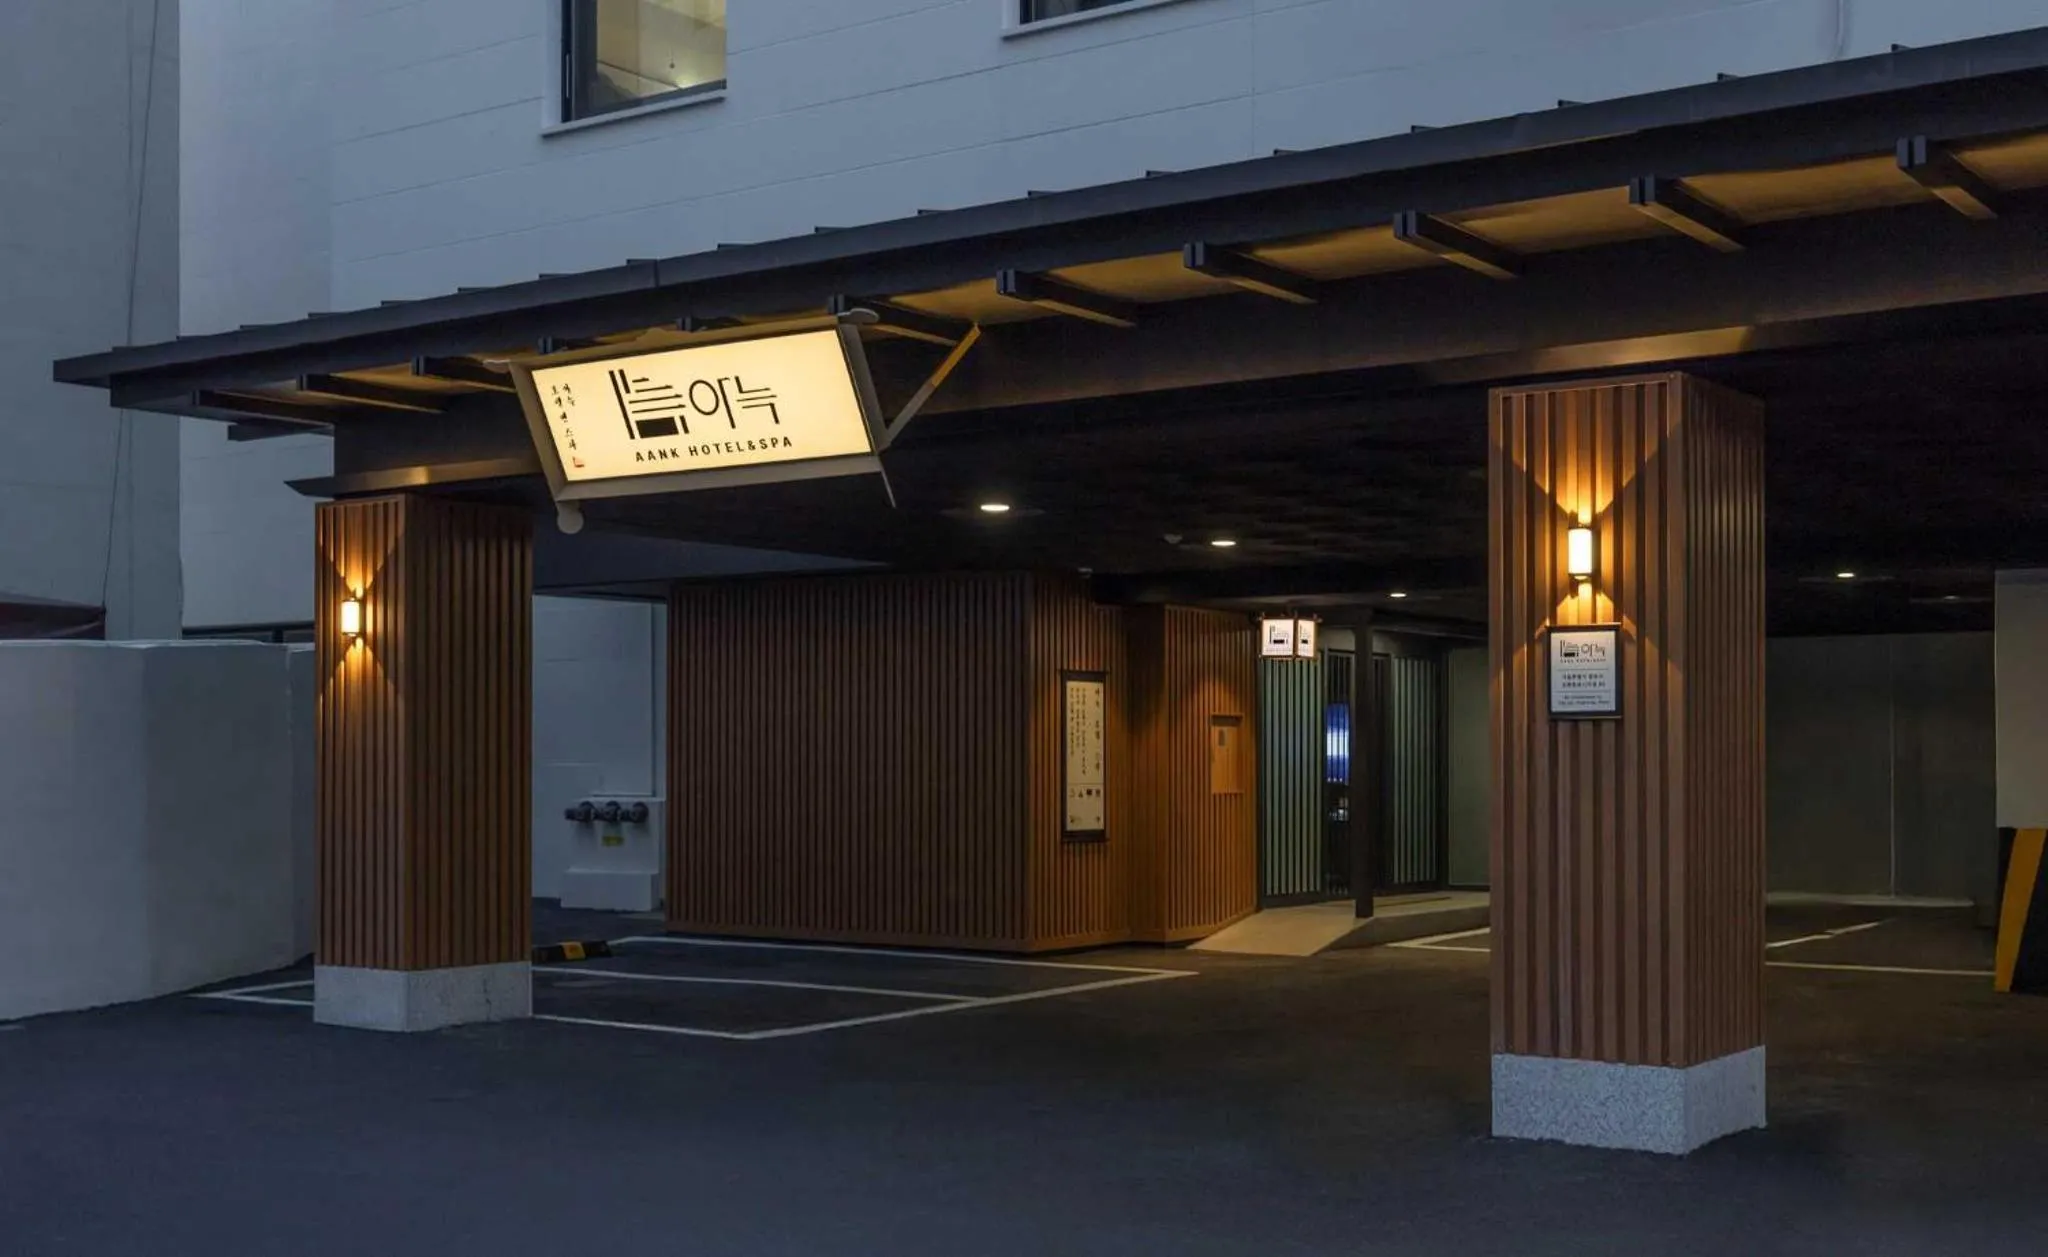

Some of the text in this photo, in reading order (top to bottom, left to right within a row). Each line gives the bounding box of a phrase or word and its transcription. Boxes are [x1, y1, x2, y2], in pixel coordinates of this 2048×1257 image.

[689, 375, 780, 430] 아늑
[635, 436, 792, 462] AANK HOTEL&SPA
